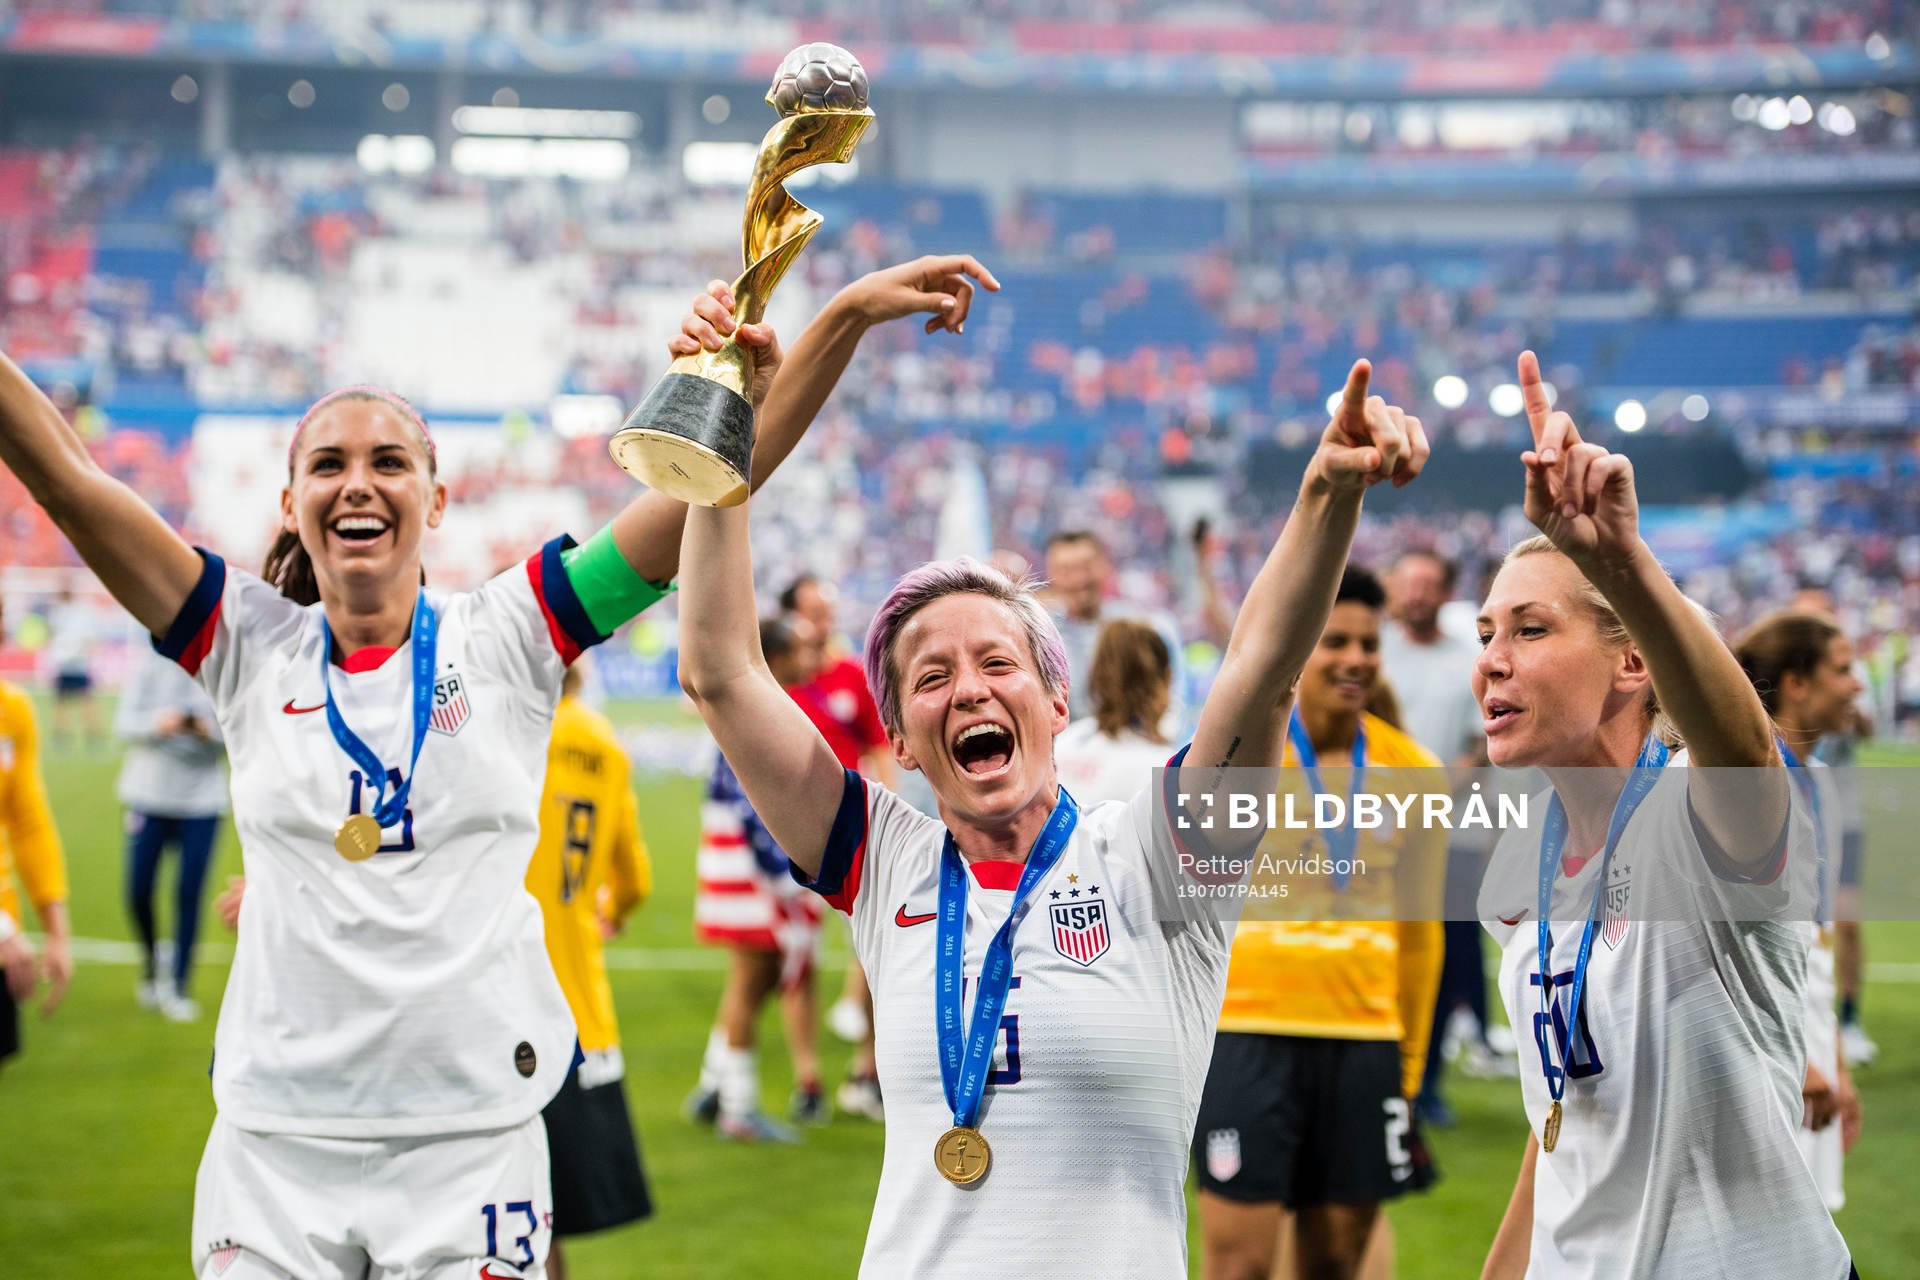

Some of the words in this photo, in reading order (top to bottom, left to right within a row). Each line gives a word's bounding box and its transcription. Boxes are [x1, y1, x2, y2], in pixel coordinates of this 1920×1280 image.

[434, 679, 459, 705] SA
[946, 900, 957, 922] FIFA
[1055, 905, 1101, 930] USA
[944, 934, 954, 957] FIFA
[944, 969, 953, 993] FIFA
[945, 1006, 953, 1030] FIFA
[982, 994, 995, 1020] FIFA
[972, 1032, 986, 1059] FIFA
[963, 1071, 977, 1097] FIFA
[481, 1200, 538, 1272] 13
